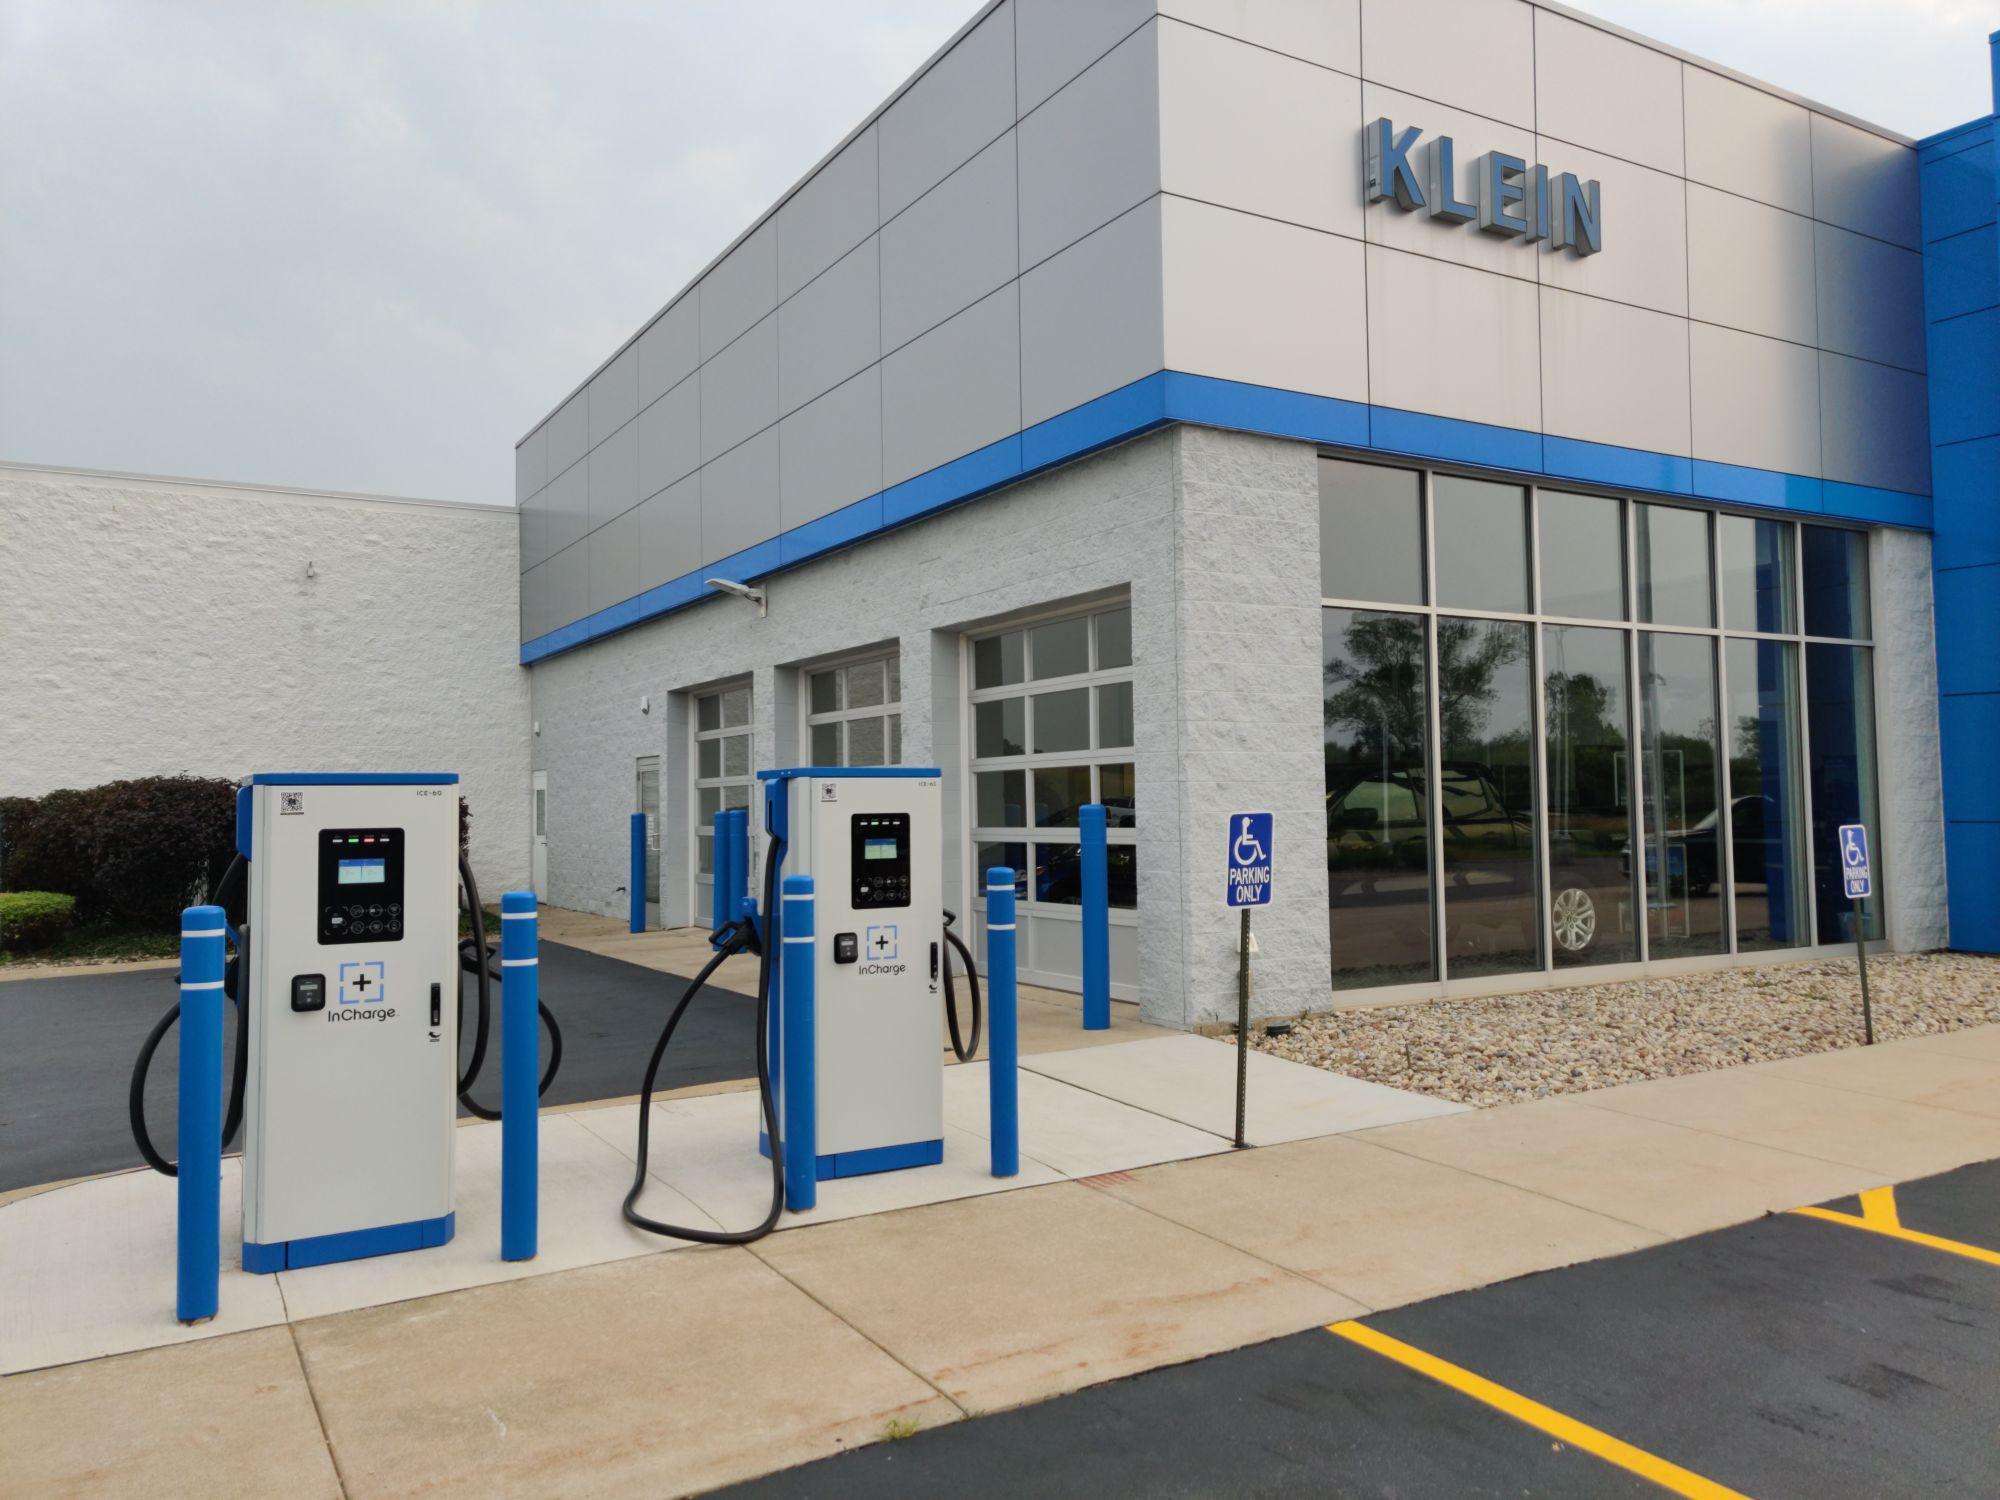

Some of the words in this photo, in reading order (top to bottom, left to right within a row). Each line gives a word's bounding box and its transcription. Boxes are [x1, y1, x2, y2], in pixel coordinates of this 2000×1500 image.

[1370, 117, 1602, 256] KLEIN
[1229, 866, 1270, 886] PARKING
[1845, 866, 1867, 879] PARKING
[1851, 879, 1864, 893] ONLY
[1236, 885, 1263, 903] ONLY
[858, 964, 906, 975] InCharge
[327, 1007, 396, 1022] InCharge
